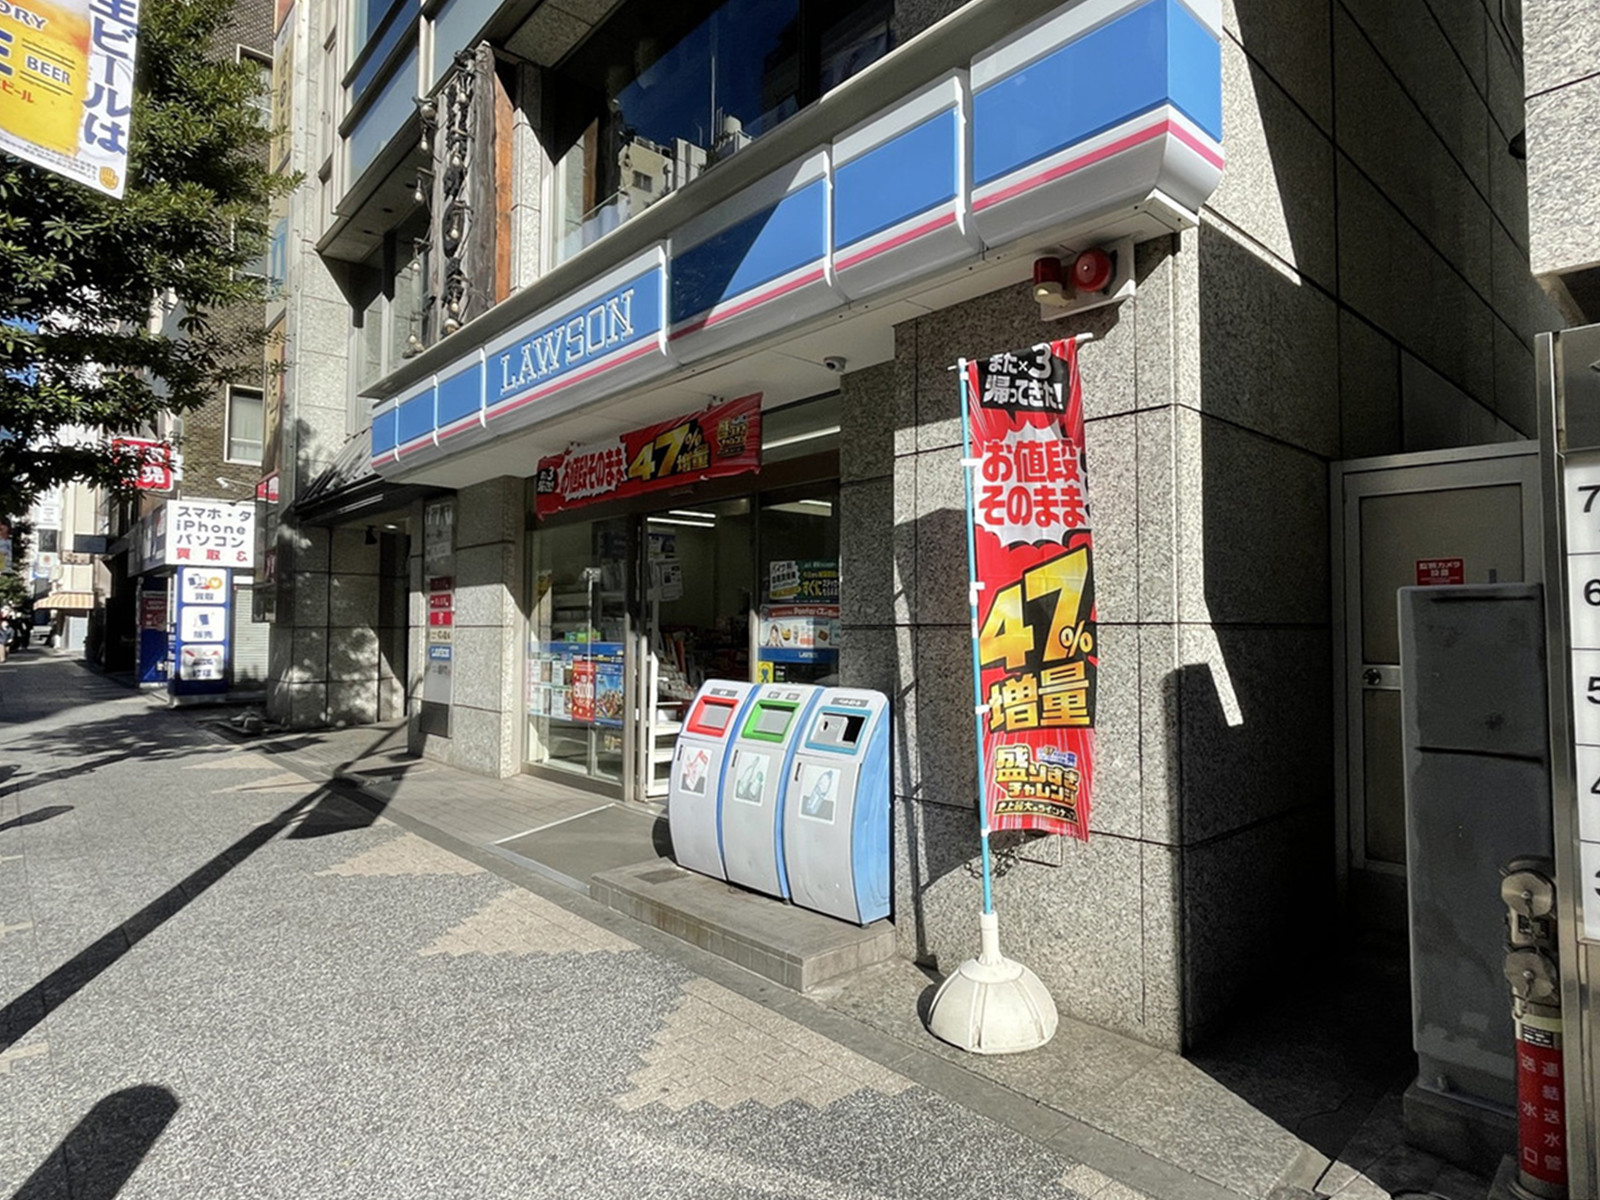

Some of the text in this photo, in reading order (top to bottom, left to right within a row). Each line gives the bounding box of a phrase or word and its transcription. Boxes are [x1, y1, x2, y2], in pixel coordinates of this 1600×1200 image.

[27, 56, 71, 86] BEER
[501, 289, 634, 395] LAWSON
[983, 374, 1063, 410] 帰ってきた!
[628, 423, 702, 481] 47%
[981, 439, 1080, 483] お値段
[177, 520, 246, 535] iPhone
[178, 506, 255, 521] スマホ・タ
[979, 485, 1086, 528] そのまま
[177, 534, 245, 547] パソコン
[979, 548, 1092, 670] 47%
[989, 661, 1090, 731] 増量
[1520, 1052, 1538, 1165] 送水口
